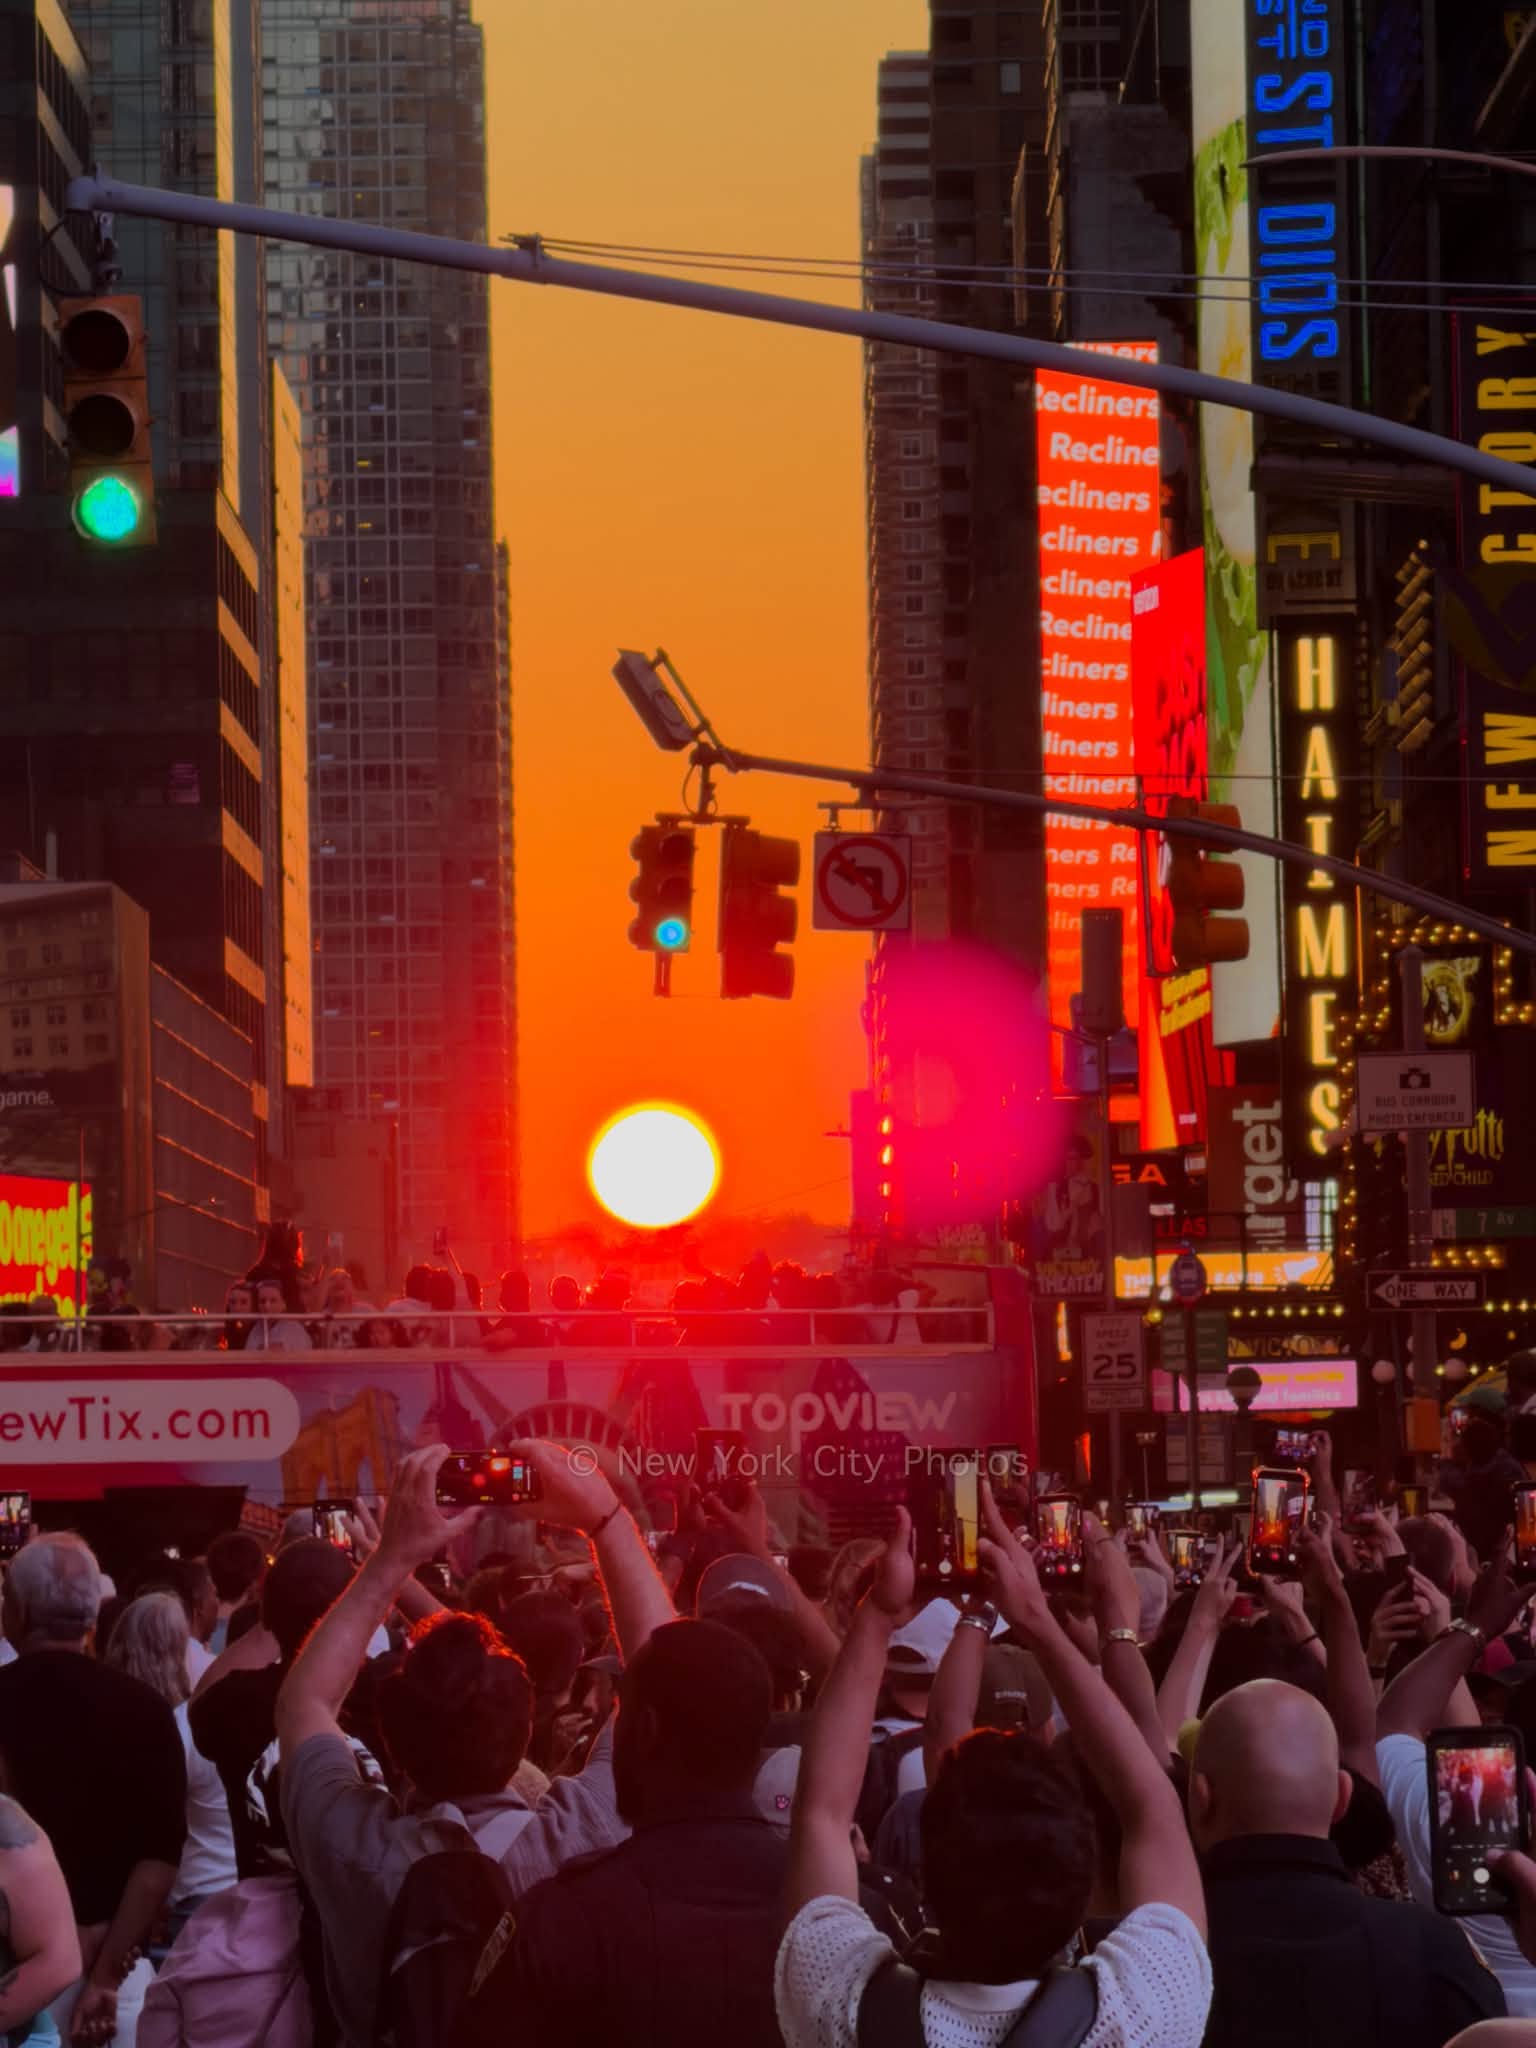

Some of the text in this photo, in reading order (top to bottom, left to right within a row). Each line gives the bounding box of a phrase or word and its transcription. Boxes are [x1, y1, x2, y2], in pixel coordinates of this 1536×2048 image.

[1256, 71, 1338, 361] STDIOS
[1298, 637, 1346, 1154] HAIMES
[1093, 1353, 1137, 1379] 25
[1386, 1281, 1470, 1298] ONE WAY
